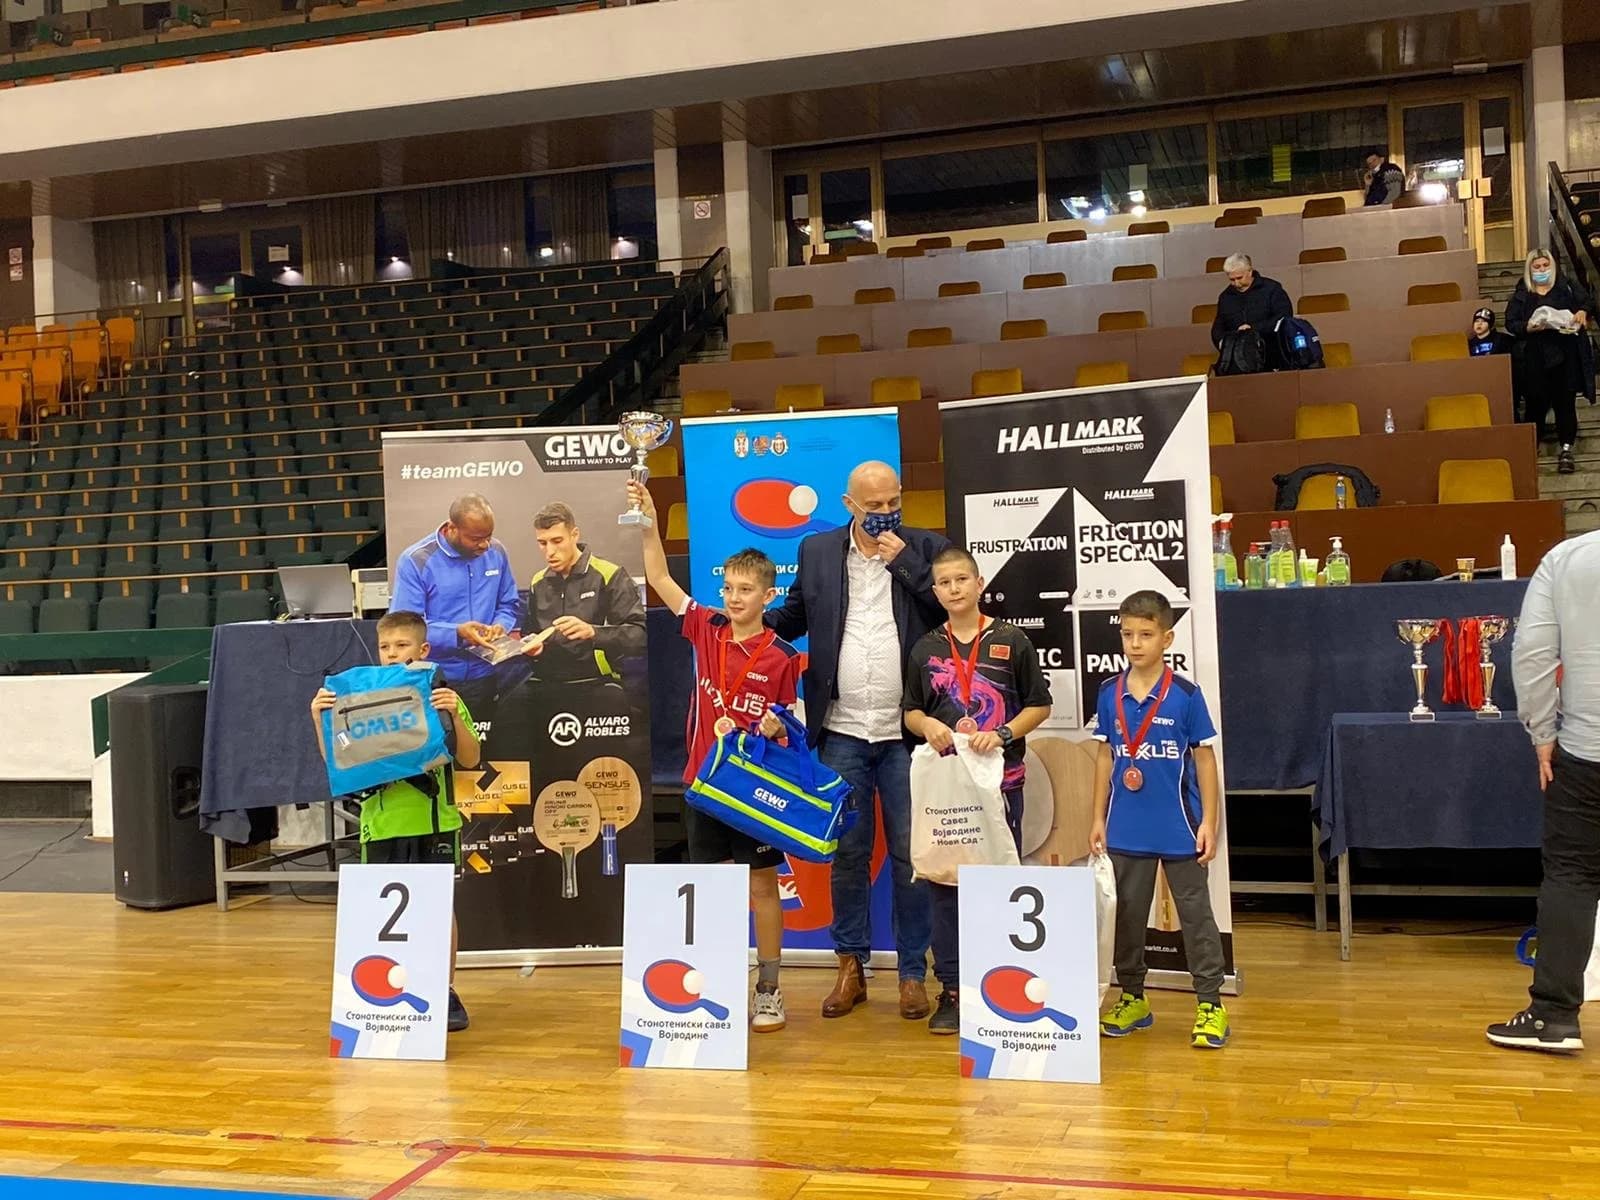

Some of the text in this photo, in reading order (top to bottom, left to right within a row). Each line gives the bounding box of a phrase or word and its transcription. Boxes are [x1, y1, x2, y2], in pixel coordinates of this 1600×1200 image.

[997, 416, 1144, 453] HALLMARK
[545, 432, 632, 459] GEWO
[1082, 445, 1115, 454] Distributed
[1125, 442, 1144, 451] GEWO
[561, 458, 586, 466] BETTER
[401, 460, 524, 479] #teamGEWO
[1104, 488, 1154, 500] HALLMARK
[993, 496, 1039, 507] HALLMARK
[1079, 520, 1184, 542] FRICTION
[969, 536, 1068, 553] FRUSTRATION
[1080, 541, 1185, 564] SPECIAL2
[1002, 617, 1045, 627] ALLMARK
[746, 671, 768, 683] GEWO
[745, 692, 766, 702] PRO
[584, 716, 630, 727] ALVARO
[1152, 716, 1175, 726] GEWO
[585, 726, 630, 737] ROBLES
[585, 780, 631, 790] SENSUS
[754, 787, 787, 809] GEWO
[941, 817, 968, 826] Савез
[932, 826, 981, 838] Војводине
[961, 837, 978, 845] Сад
[378, 882, 410, 942] 2
[677, 883, 695, 945] 1
[1008, 885, 1046, 952] 3
[346, 1011, 432, 1022] Стонотениски савез
[365, 1022, 411, 1033] Војводине
[636, 1018, 731, 1029] Стонотениски савез
[659, 1030, 709, 1041] Војводине
[977, 1027, 1082, 1040] Стонотениски савез
[1002, 1039, 1057, 1052] Војводине
